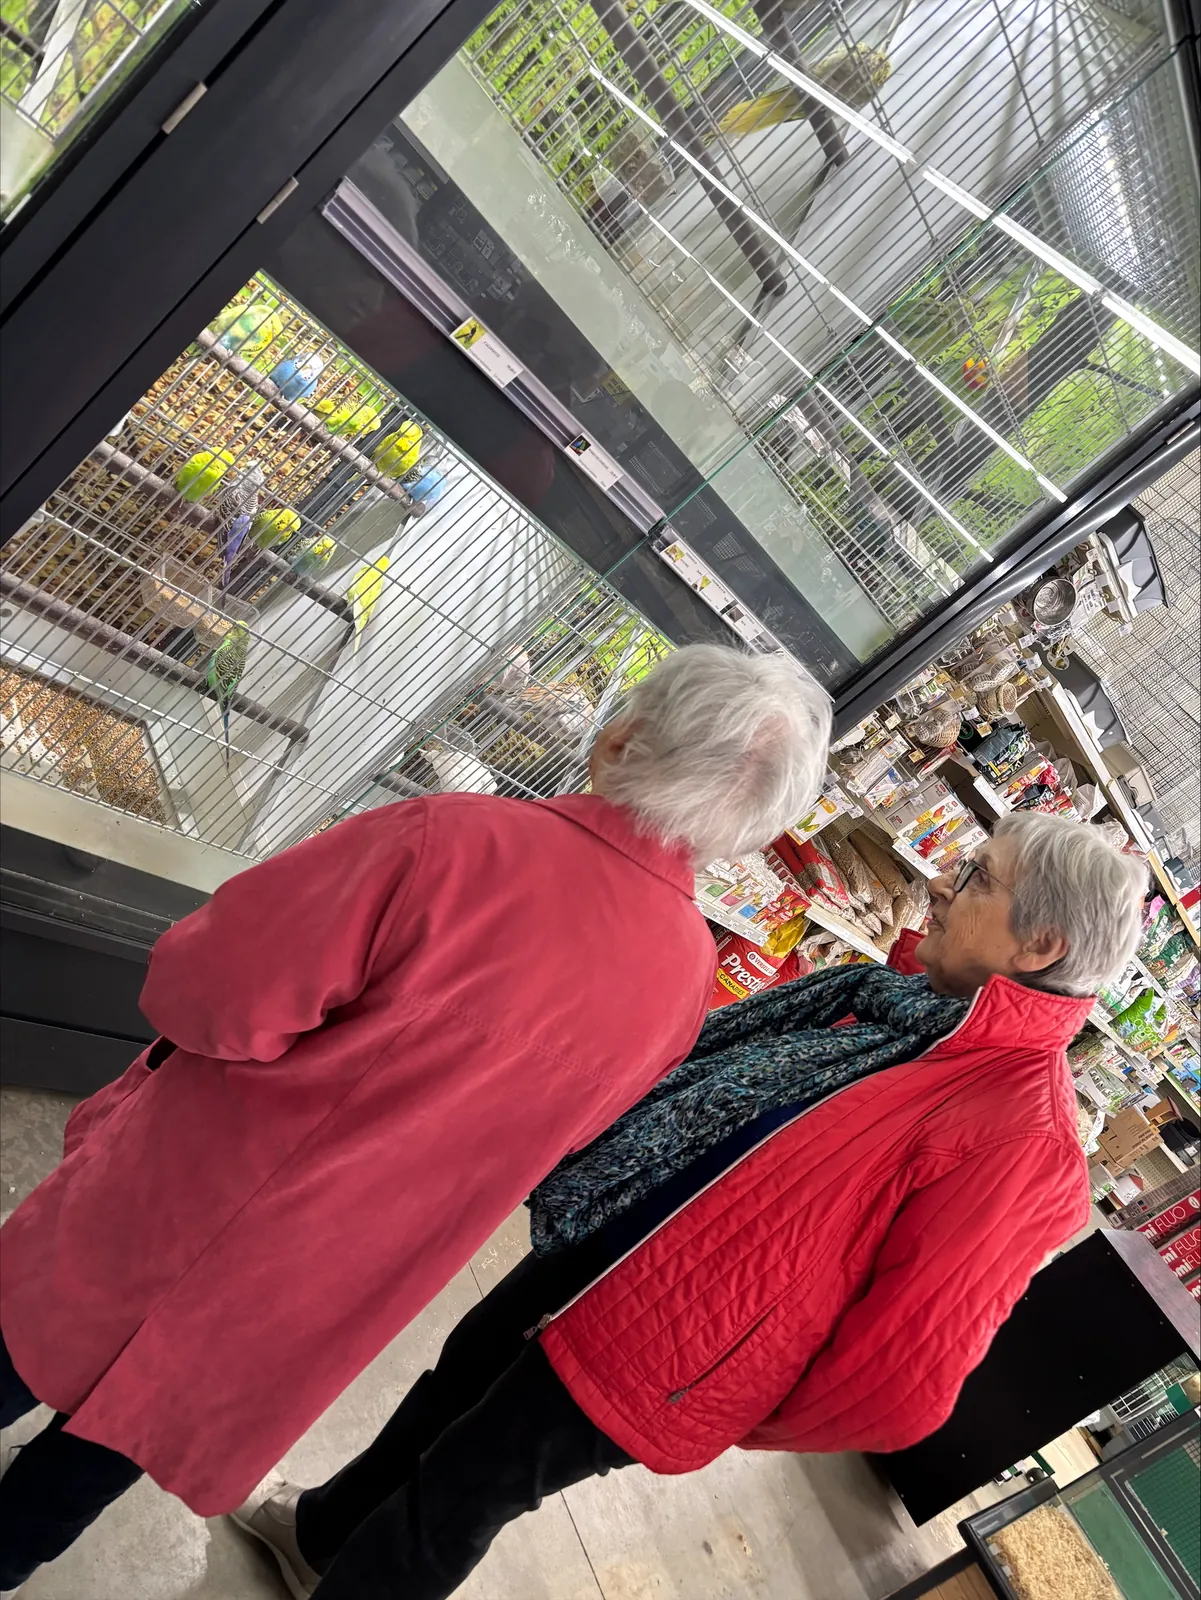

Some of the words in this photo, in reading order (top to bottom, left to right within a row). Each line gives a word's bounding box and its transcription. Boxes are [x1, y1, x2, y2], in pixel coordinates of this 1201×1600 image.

[1143, 1223, 1158, 1239] mi
[1155, 1206, 1186, 1231] FLUO
[1162, 1246, 1178, 1263] mi
